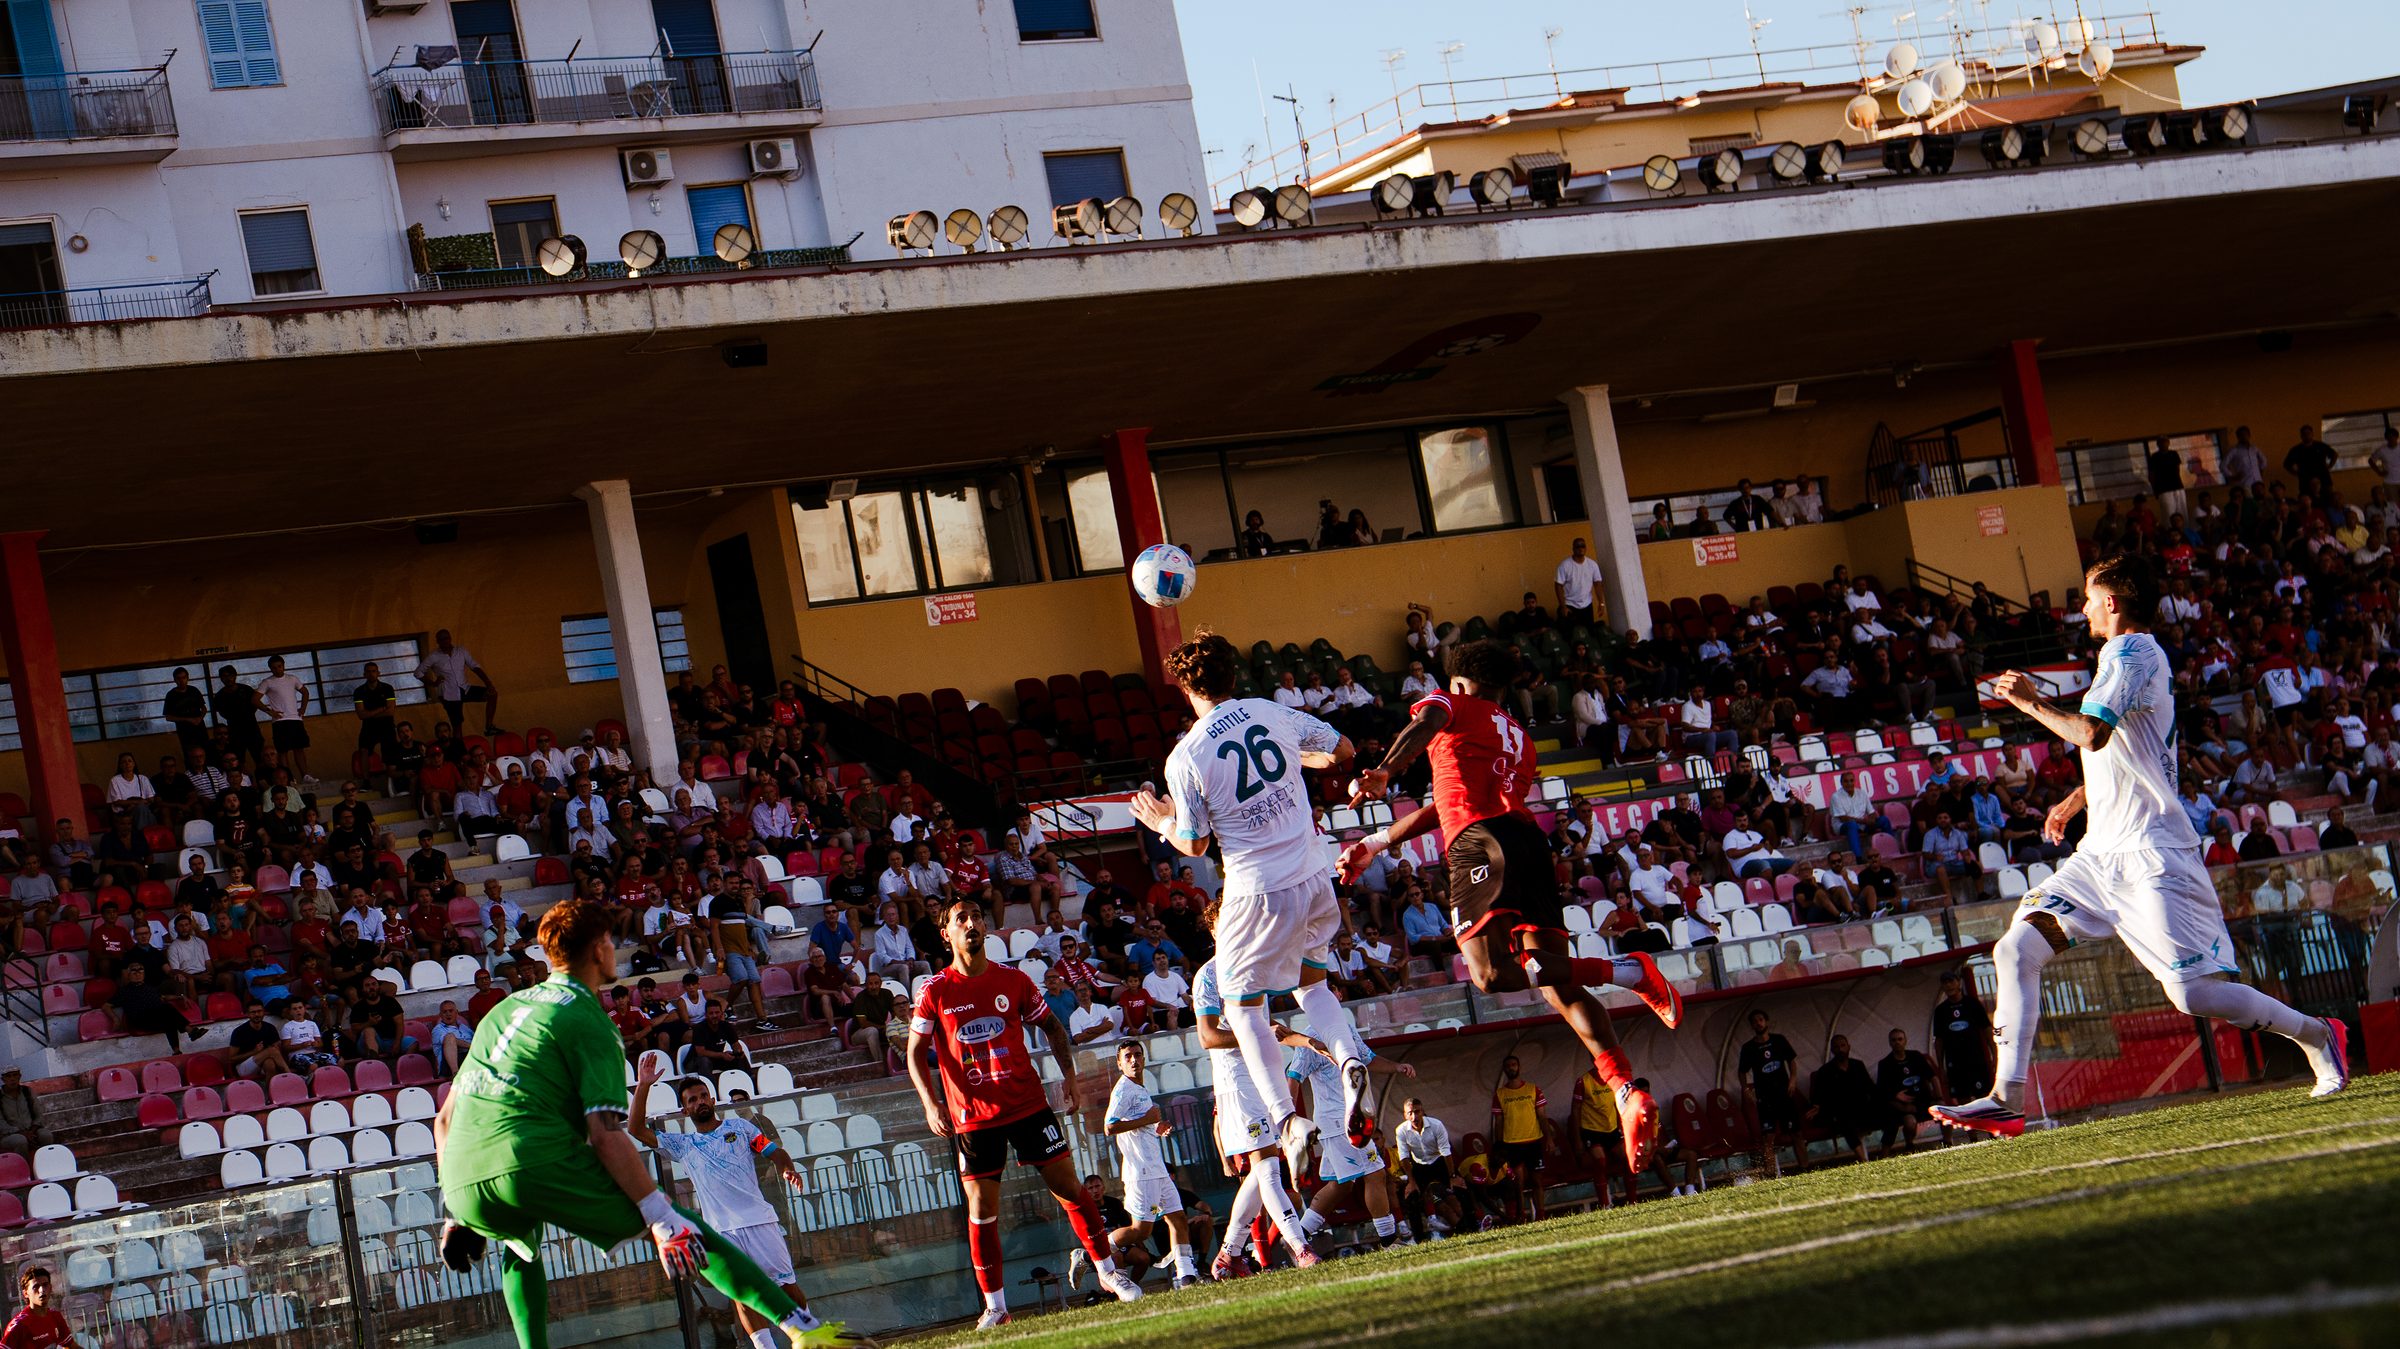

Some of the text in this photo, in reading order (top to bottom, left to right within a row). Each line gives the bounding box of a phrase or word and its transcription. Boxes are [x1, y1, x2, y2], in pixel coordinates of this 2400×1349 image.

[940, 601, 976, 611] TRIBUNA VIP
[963, 608, 977, 619] 34
[1206, 707, 1251, 739] GENTILE
[1217, 724, 1287, 803] 26
[2044, 894, 2077, 915] 77
[943, 1003, 975, 1015] GIVOVA
[490, 1006, 534, 1063] 1
[1042, 1124, 1060, 1142] 10
[1260, 1118, 1270, 1134] 5
